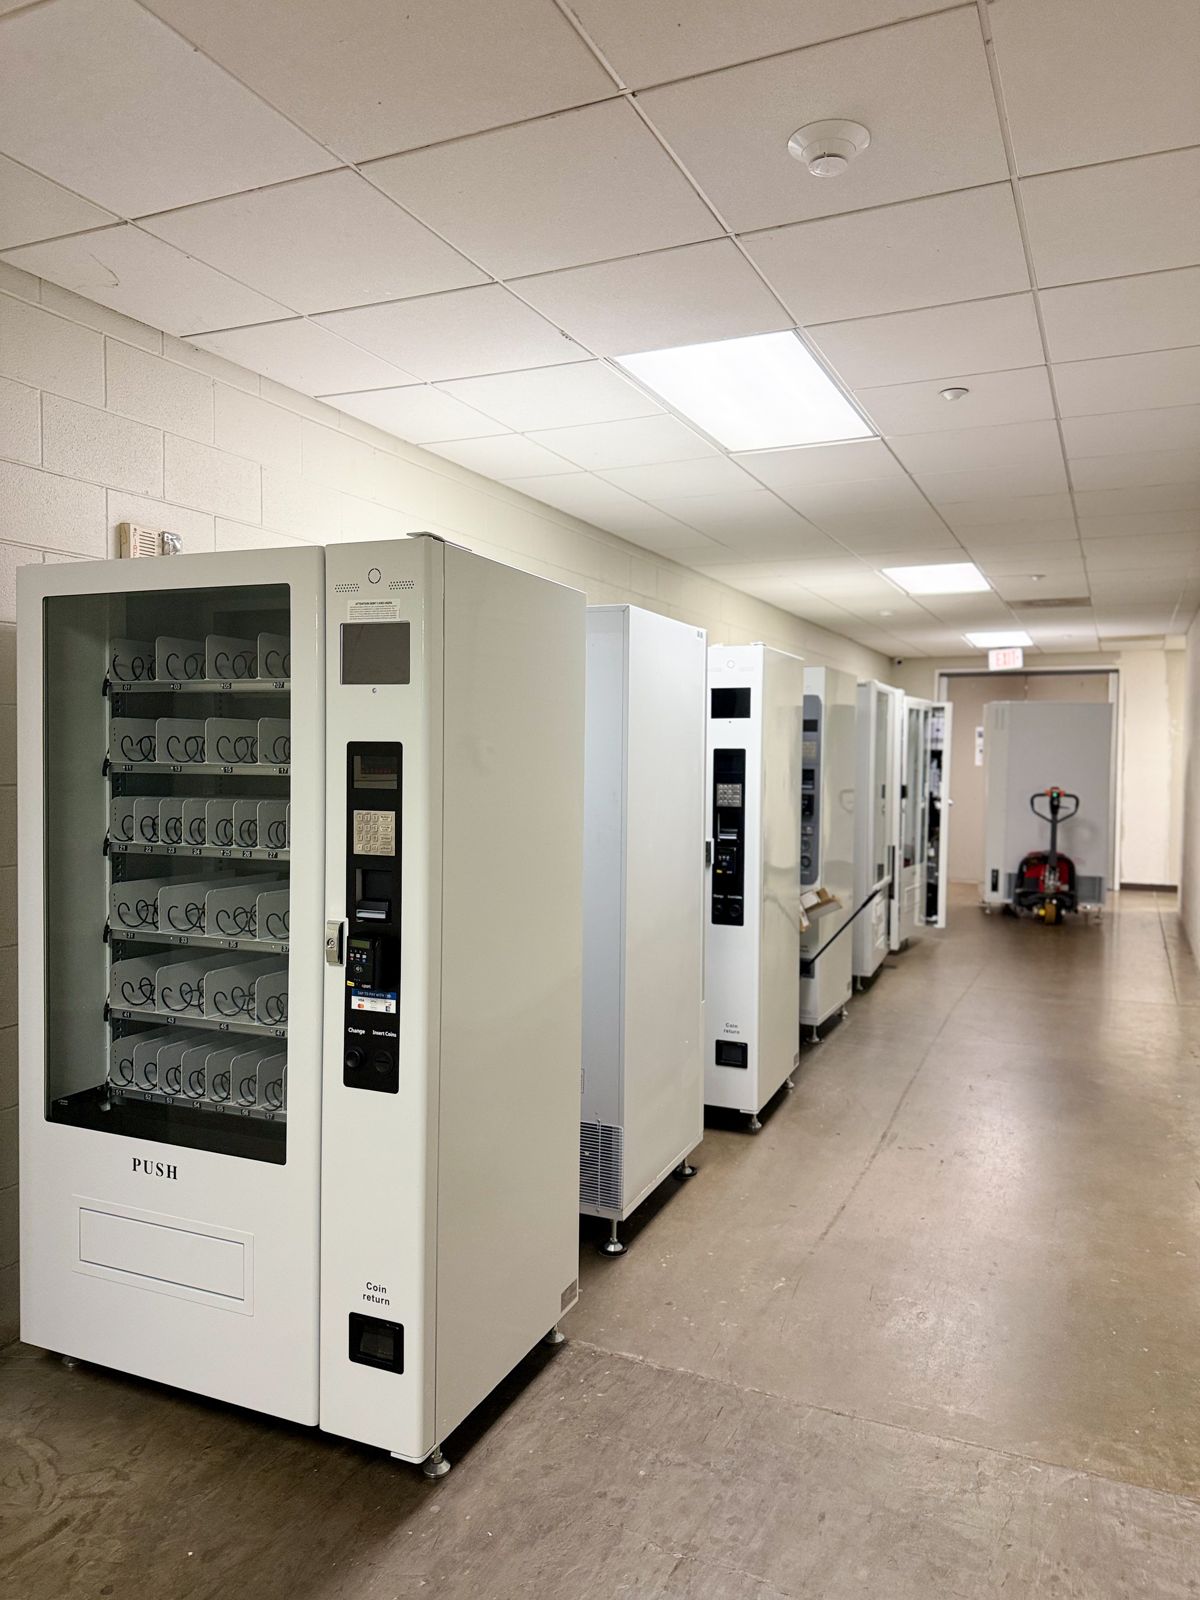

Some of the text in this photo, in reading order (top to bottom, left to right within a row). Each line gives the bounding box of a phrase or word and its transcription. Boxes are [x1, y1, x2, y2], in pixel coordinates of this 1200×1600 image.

[348, 1026, 366, 1035] Change
[132, 1157, 178, 1180] PUSH
[366, 1281, 387, 1294] Coin
[362, 1293, 390, 1306] return
